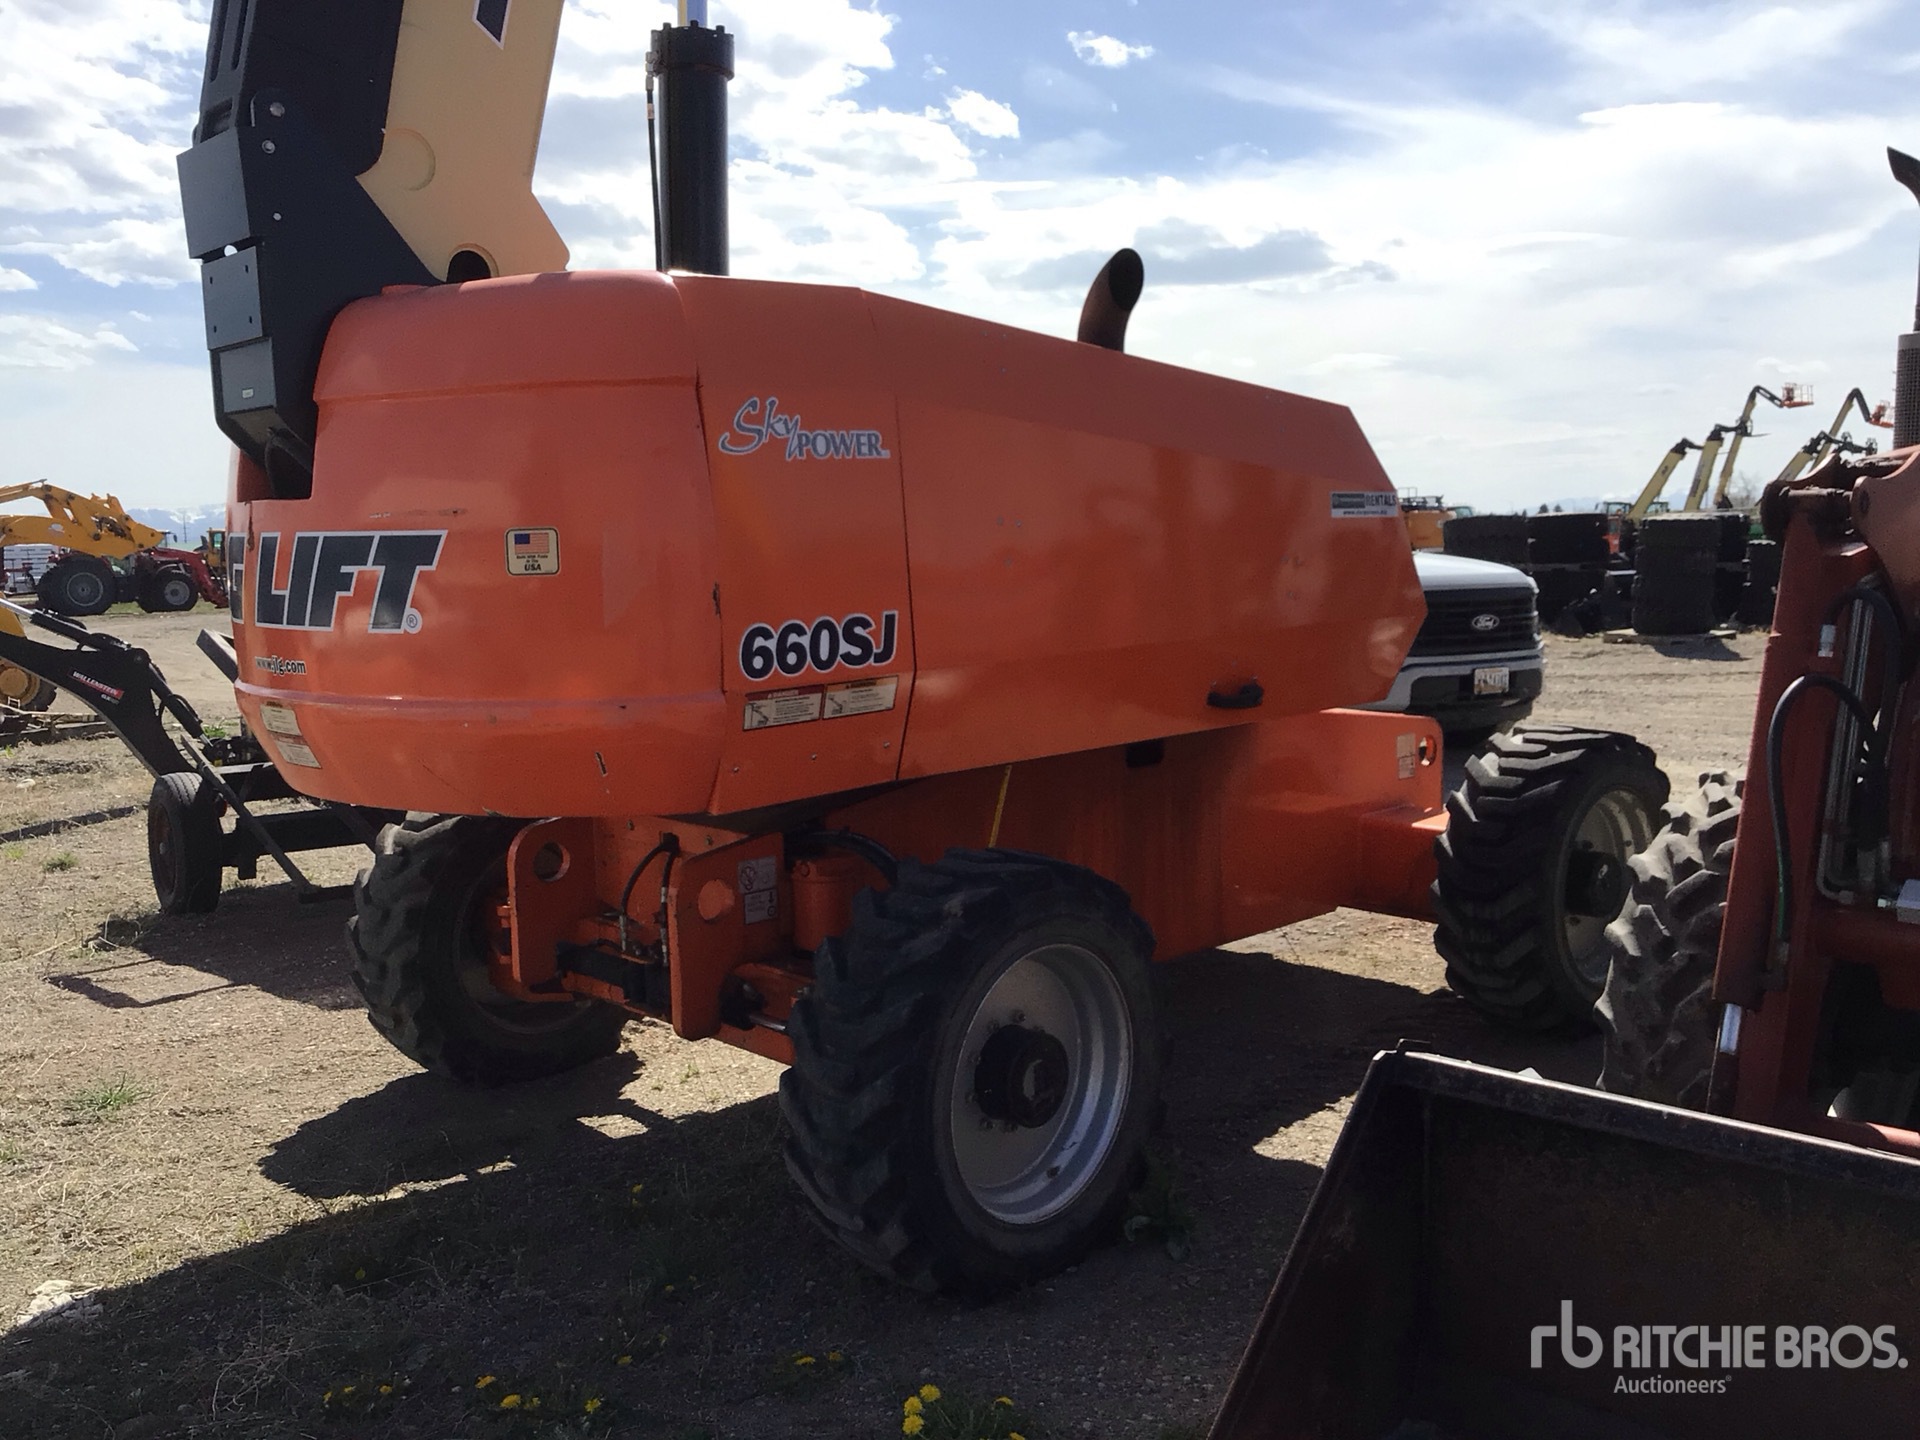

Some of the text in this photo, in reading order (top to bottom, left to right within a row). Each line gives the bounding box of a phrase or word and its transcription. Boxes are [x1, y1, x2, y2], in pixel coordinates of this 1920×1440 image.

[796, 430, 890, 459] POWER
[255, 530, 448, 633] LIFT
[523, 563, 542, 572] USA
[740, 610, 899, 681] 660SJ
[255, 655, 308, 676] www.jlg.com
